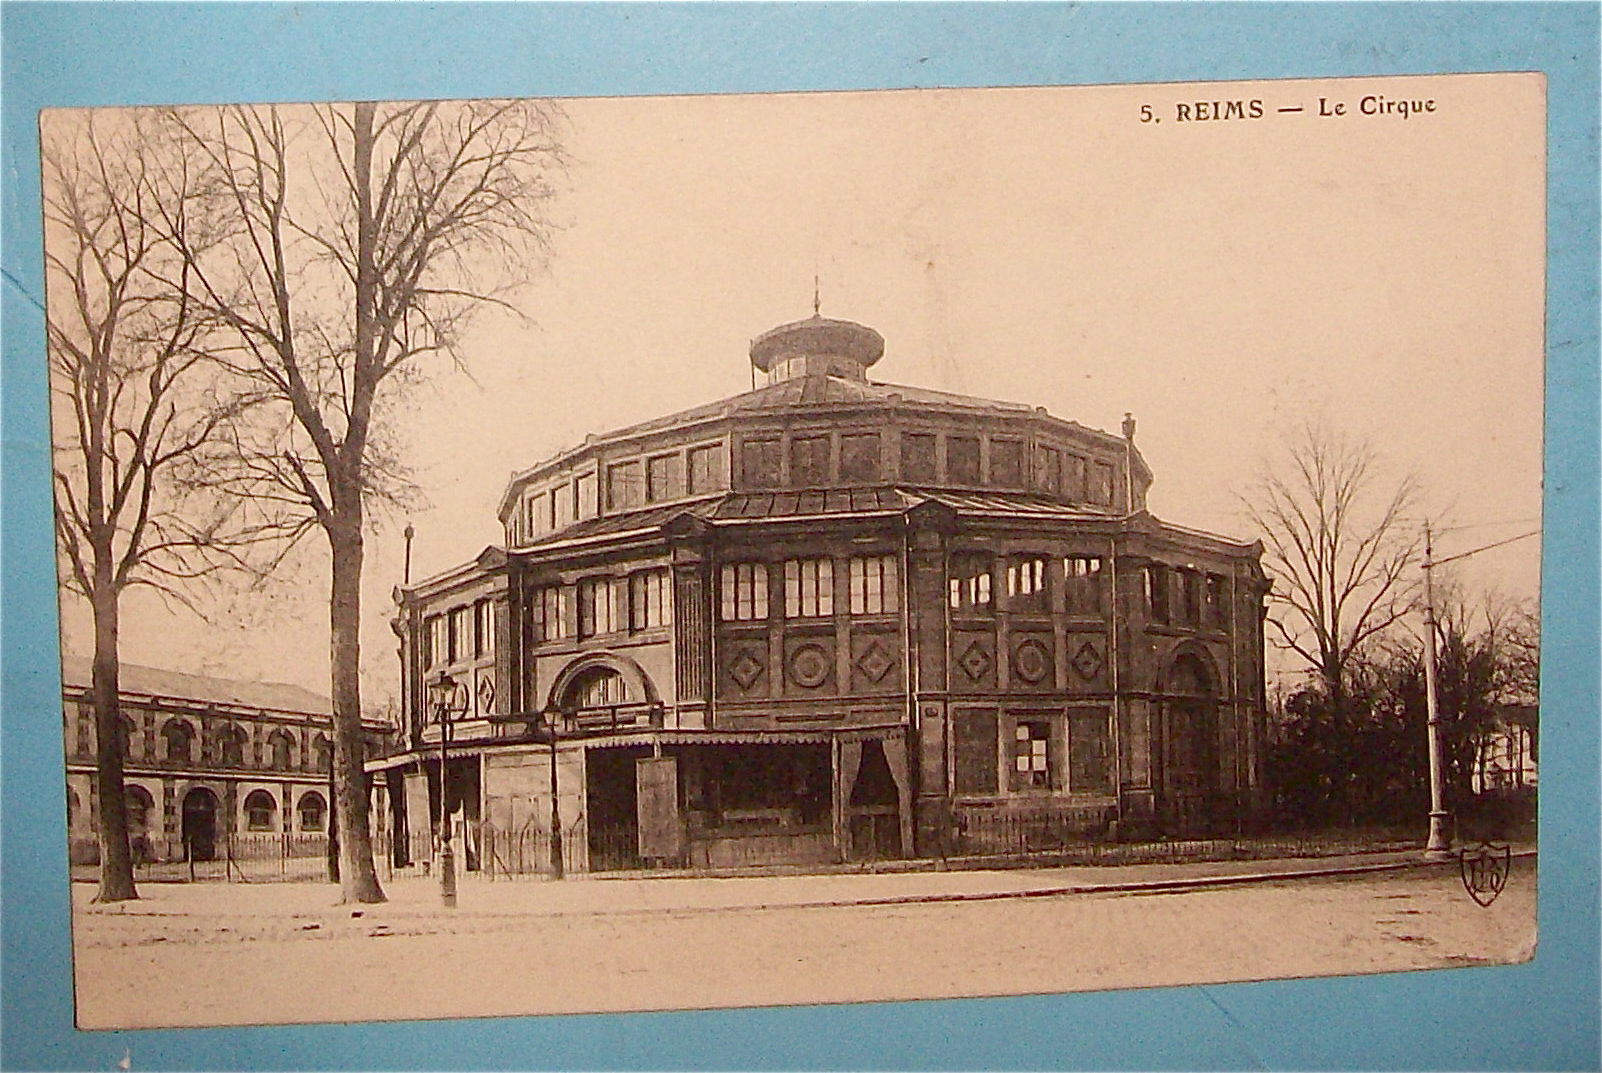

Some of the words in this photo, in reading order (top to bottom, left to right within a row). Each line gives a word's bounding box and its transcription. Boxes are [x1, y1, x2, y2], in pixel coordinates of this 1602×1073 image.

[1140, 104, 1160, 123] 5.
[1176, 100, 1264, 122] REIMS
[1319, 98, 1347, 116] Le
[1360, 95, 1437, 120] Cirque
